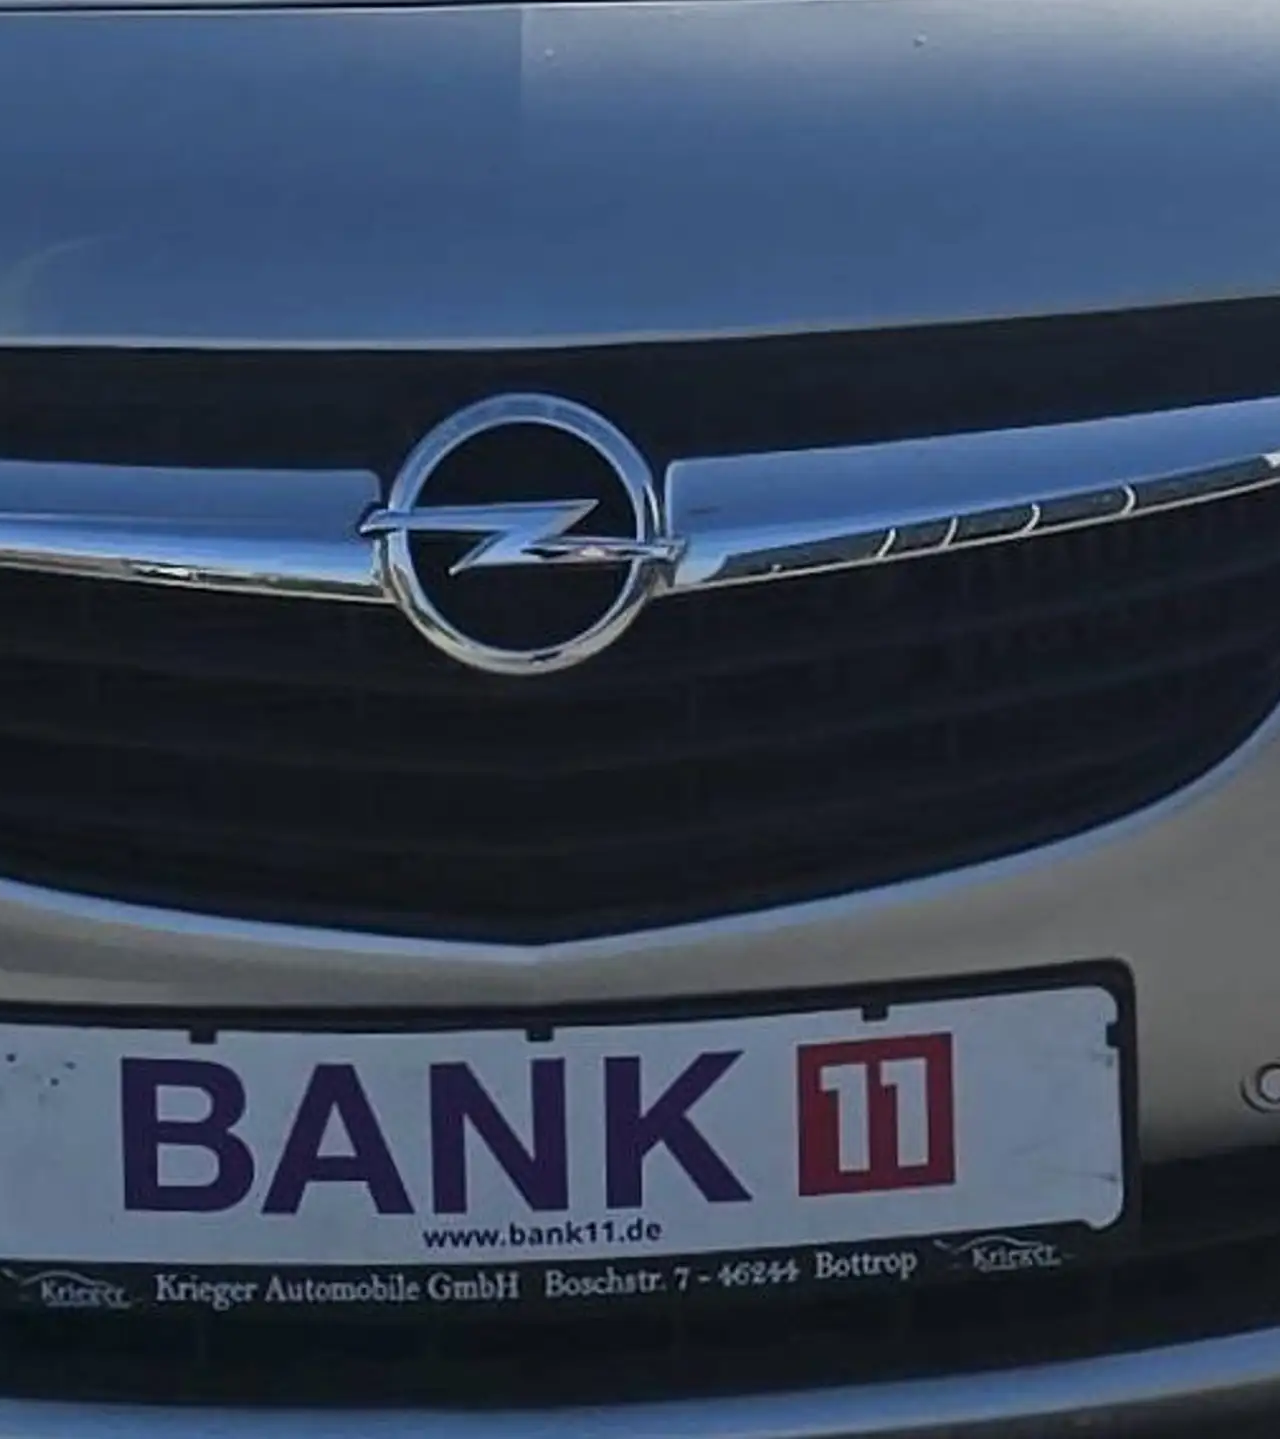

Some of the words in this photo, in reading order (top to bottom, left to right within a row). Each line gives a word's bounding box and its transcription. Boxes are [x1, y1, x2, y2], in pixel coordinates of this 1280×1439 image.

[120, 1049, 754, 1215] BANK
[818, 1055, 930, 1174] 11
[422, 1216, 663, 1252] www.bank11.de
[154, 1271, 257, 1311] Krieger
[265, 1271, 420, 1304] Automobile
[427, 1267, 520, 1301] GmbH
[543, 1266, 668, 1299] Boschstr.
[674, 1267, 690, 1292] 7
[718, 1259, 802, 1289] 46244
[815, 1250, 919, 1281] Bottrop
